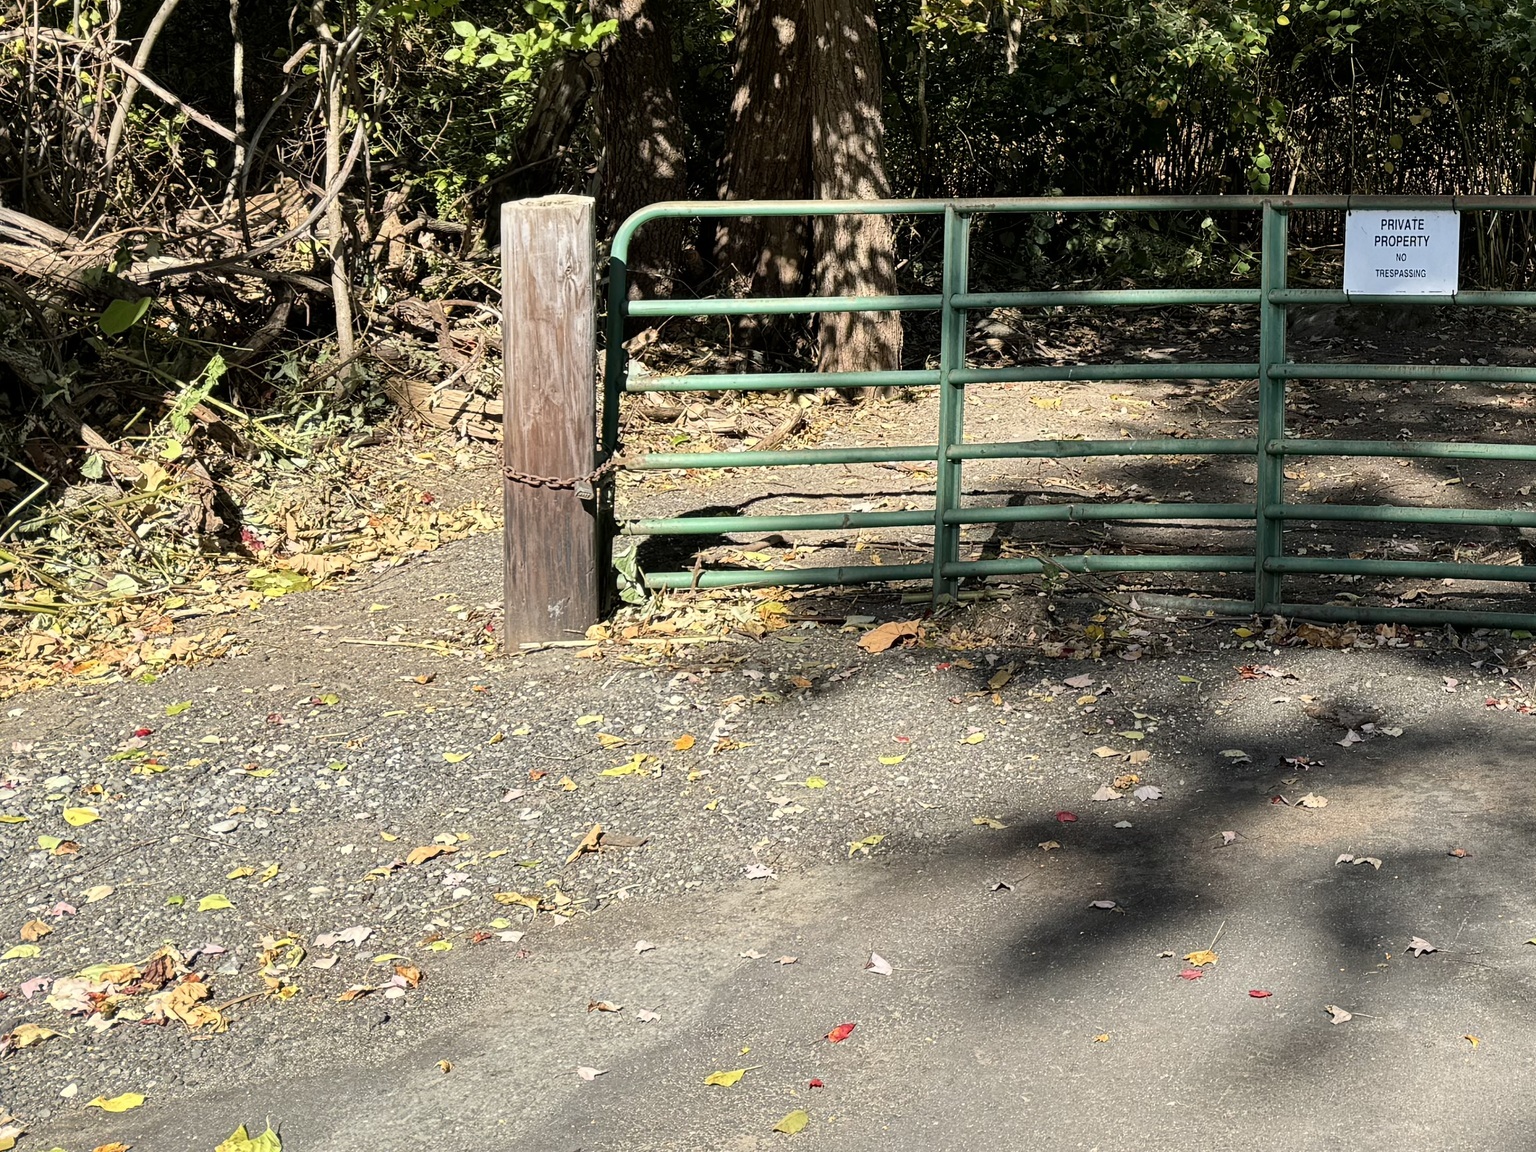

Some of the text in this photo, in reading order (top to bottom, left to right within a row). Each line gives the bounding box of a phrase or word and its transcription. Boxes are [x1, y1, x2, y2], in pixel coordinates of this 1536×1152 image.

[1381, 219, 1425, 230] PRIVATE
[1374, 235, 1430, 247] PROPERTY
[1395, 253, 1407, 262] NO
[1375, 269, 1426, 278] TRESPASSING
